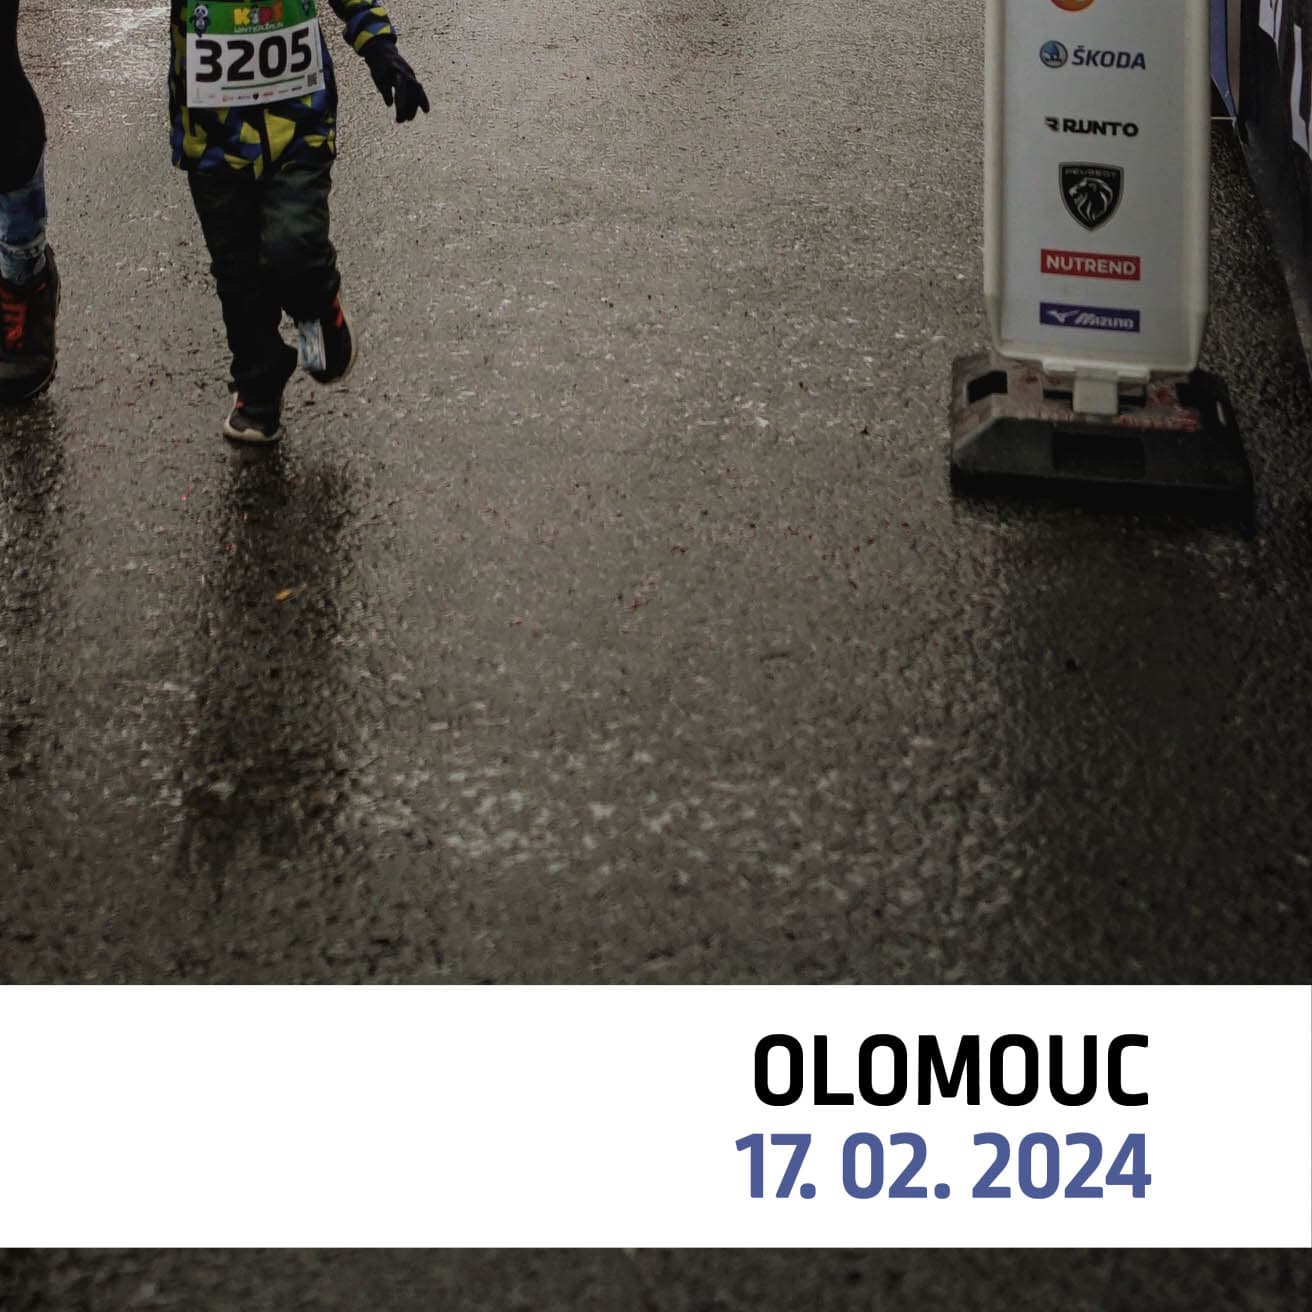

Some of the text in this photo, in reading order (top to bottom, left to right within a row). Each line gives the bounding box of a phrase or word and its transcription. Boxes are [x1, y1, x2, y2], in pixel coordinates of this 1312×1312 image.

[195, 27, 312, 83] 3205
[1072, 45, 1146, 70] ŠKODA
[1063, 118, 1139, 137] RUNTO
[1046, 254, 1137, 275] NUTREND
